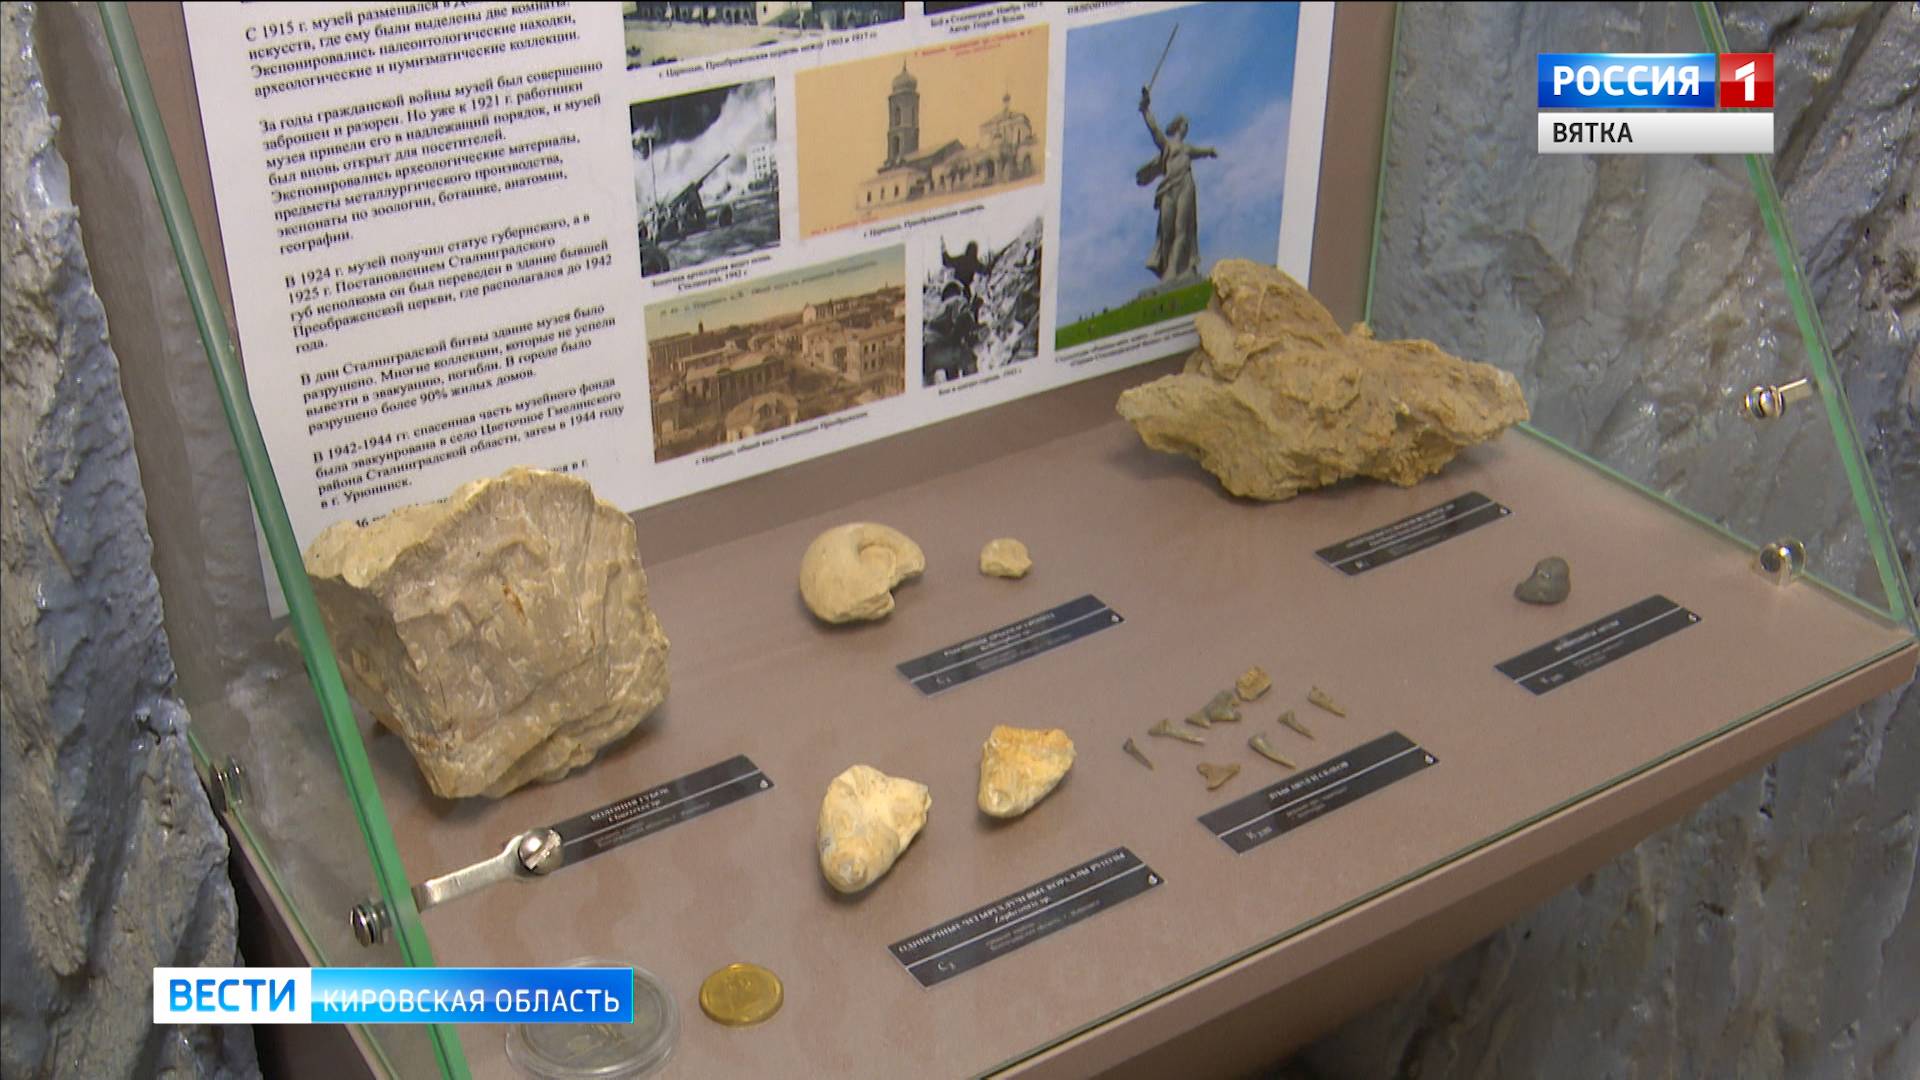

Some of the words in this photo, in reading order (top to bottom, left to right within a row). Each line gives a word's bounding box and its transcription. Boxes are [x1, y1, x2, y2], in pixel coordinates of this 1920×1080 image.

[248, 39, 315, 60] искусств,
[319, 34, 341, 47] где
[344, 29, 370, 43] ему
[374, 23, 410, 37] были
[414, 11, 481, 31] выделены
[485, 7, 507, 20] две
[250, 47, 375, 78] Экспонировались
[379, 23, 516, 55] палеонтологические
[519, 14, 576, 31] находки,
[262, 19, 294, 39] 1915
[311, 11, 353, 31] музей
[356, 2, 438, 25] размещался
[254, 66, 372, 98] археологические
[388, 43, 506, 74] нумизматические
[279, 113, 313, 129] годы
[316, 93, 404, 123] гражданской
[408, 88, 451, 105] войны
[454, 77, 493, 97] музей
[496, 75, 522, 88] был
[526, 61, 602, 83] совершенно
[262, 129, 329, 151] заброшен
[430, 105, 455, 121] уже
[471, 93, 499, 110] 1921
[516, 81, 582, 105] работники
[265, 151, 305, 169] музея
[309, 140, 365, 161] привели
[369, 135, 391, 147] его
[405, 114, 489, 141] надлежащий
[493, 106, 549, 124] порядок,
[564, 92, 601, 111] музей
[268, 172, 296, 186] был
[300, 163, 339, 179] вновь
[342, 152, 391, 170] открыт
[394, 147, 417, 161] для
[270, 170, 391, 203] Экспонировались
[394, 147, 505, 179] археологические
[508, 133, 580, 155] материалы,
[273, 198, 340, 221] предметы
[344, 172, 471, 205] металлургического
[474, 154, 563, 180] производства,
[276, 214, 347, 237] экспонаты
[371, 196, 435, 217] зоологии,
[438, 183, 501, 203] ботанике,
[504, 169, 567, 190] анатомии,
[288, 286, 319, 304] 1925
[335, 261, 445, 293] Постановлением
[448, 237, 555, 268] Сталинградского
[289, 305, 312, 323] губ
[316, 291, 386, 315] исполкома
[408, 280, 434, 293] был
[437, 265, 501, 287] переведен
[515, 253, 556, 269] здание
[559, 239, 608, 259] бывшей
[300, 266, 330, 284] 1924
[347, 255, 386, 274] музей
[390, 244, 444, 264] получил
[447, 235, 487, 252] статус
[491, 218, 570, 244] губернского,
[292, 301, 404, 338] Преображенской
[407, 293, 456, 311] церкви,
[459, 287, 478, 299] где
[482, 267, 563, 296] располагался
[586, 253, 611, 270] 1942
[315, 368, 339, 383] дни
[342, 343, 446, 374] Сталинградской
[449, 332, 488, 348] битвы
[491, 321, 533, 338] здание
[536, 312, 570, 329] музея
[573, 303, 604, 319] было
[380, 362, 430, 382] Многие
[433, 346, 502, 369] коллекции,
[505, 332, 554, 351] которые
[575, 317, 615, 337] успели
[305, 396, 358, 417] вывезти
[372, 376, 444, 399] эвакуацию,
[518, 347, 557, 364] городе
[560, 338, 591, 353] было
[308, 407, 377, 436] разрушено
[380, 398, 416, 413] более
[419, 388, 448, 404] 90%
[450, 379, 492, 396] жилых
[315, 463, 348, 478] была
[351, 440, 436, 468] эвакуирована
[449, 429, 477, 443] село
[480, 411, 544, 435] Цветочное
[547, 391, 621, 418] Гмелинского
[317, 475, 363, 497] района
[365, 445, 466, 480] Сталинградской
[469, 433, 520, 453] области,
[523, 423, 556, 438] затем
[570, 410, 595, 427] 1944
[599, 405, 624, 418] году
[328, 432, 392, 459] 1942-1944
[413, 413, 475, 437] спасенная
[478, 405, 512, 419] часть
[514, 387, 576, 411] музейного
[578, 377, 615, 396] фонда
